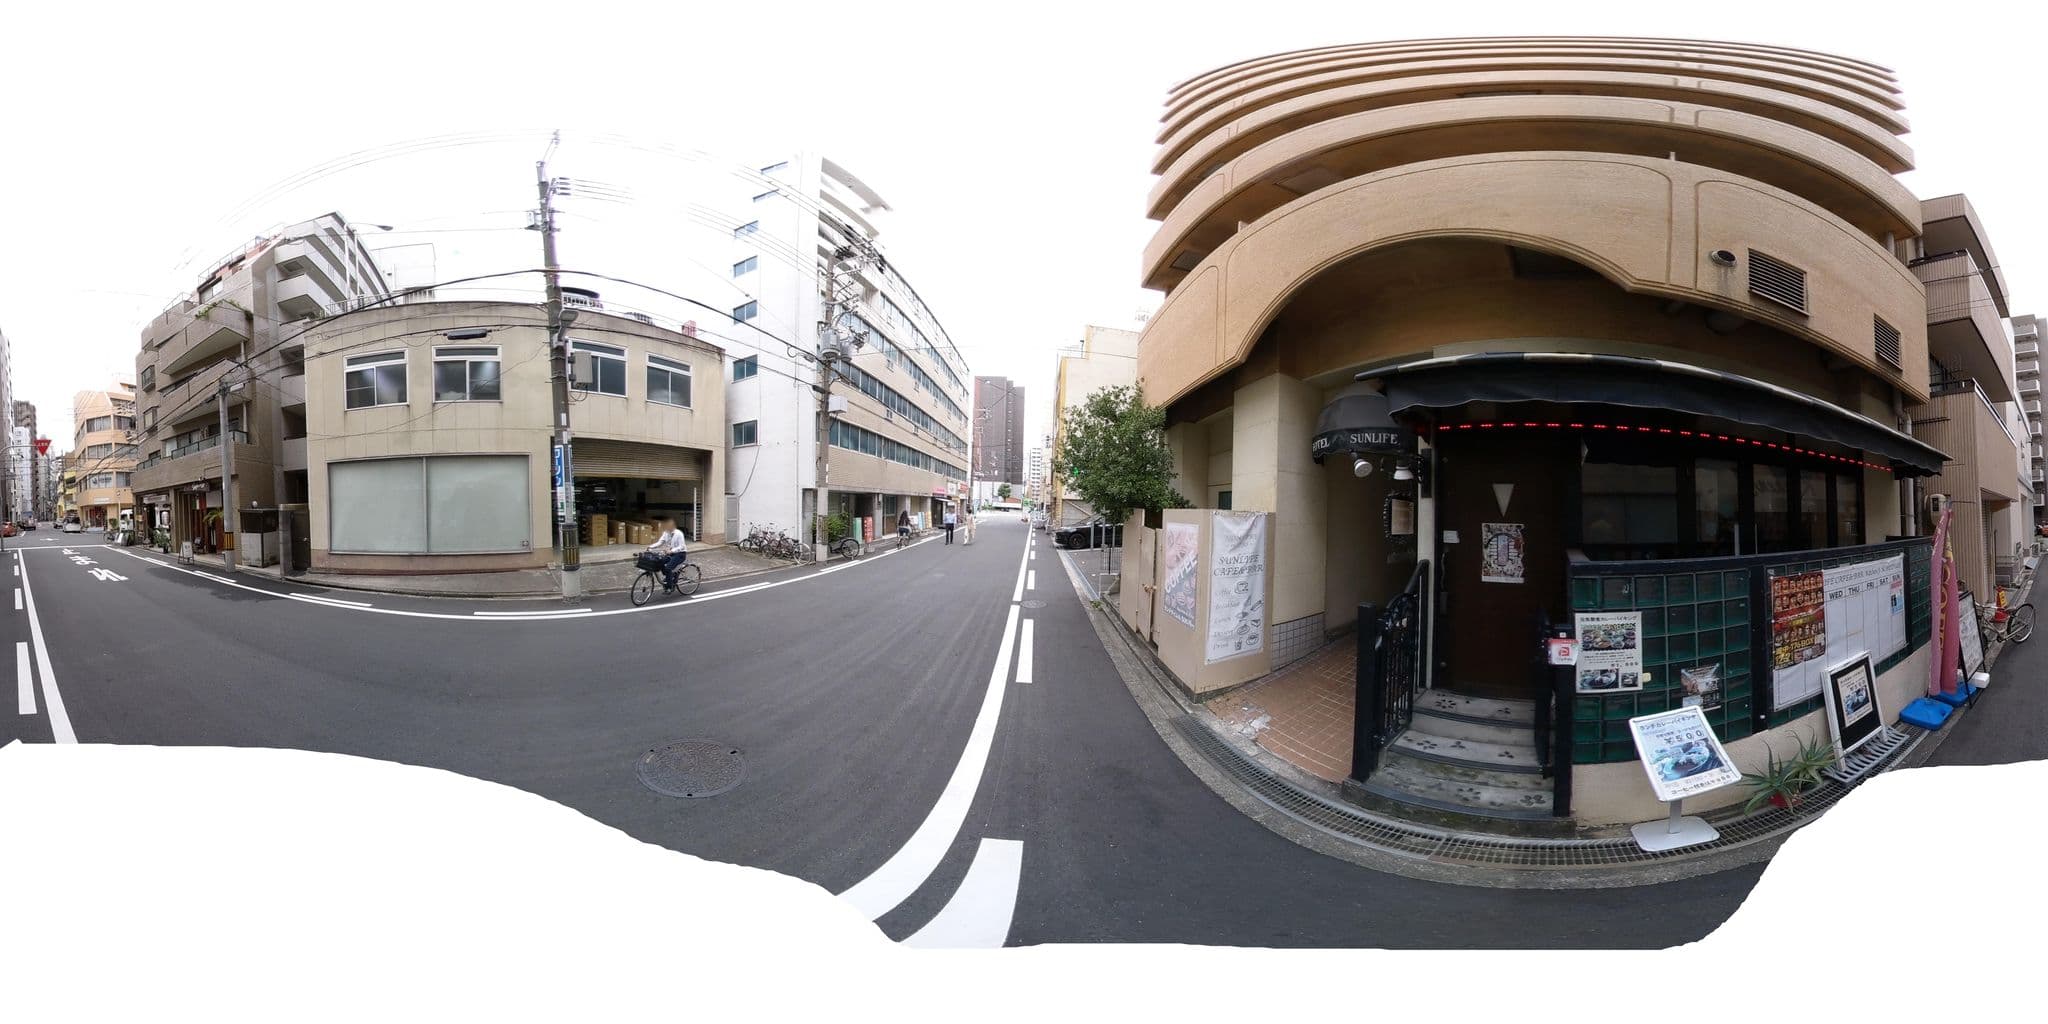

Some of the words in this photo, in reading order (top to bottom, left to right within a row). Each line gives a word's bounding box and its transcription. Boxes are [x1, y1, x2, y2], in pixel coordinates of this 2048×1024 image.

[1349, 433, 1398, 445] SUNLIFE
[1165, 550, 1198, 593] COFFEE
[1829, 591, 1844, 600] WED
[1848, 586, 1860, 595] THU
[1866, 582, 1875, 590] FRI
[1879, 577, 1889, 585] SAT
